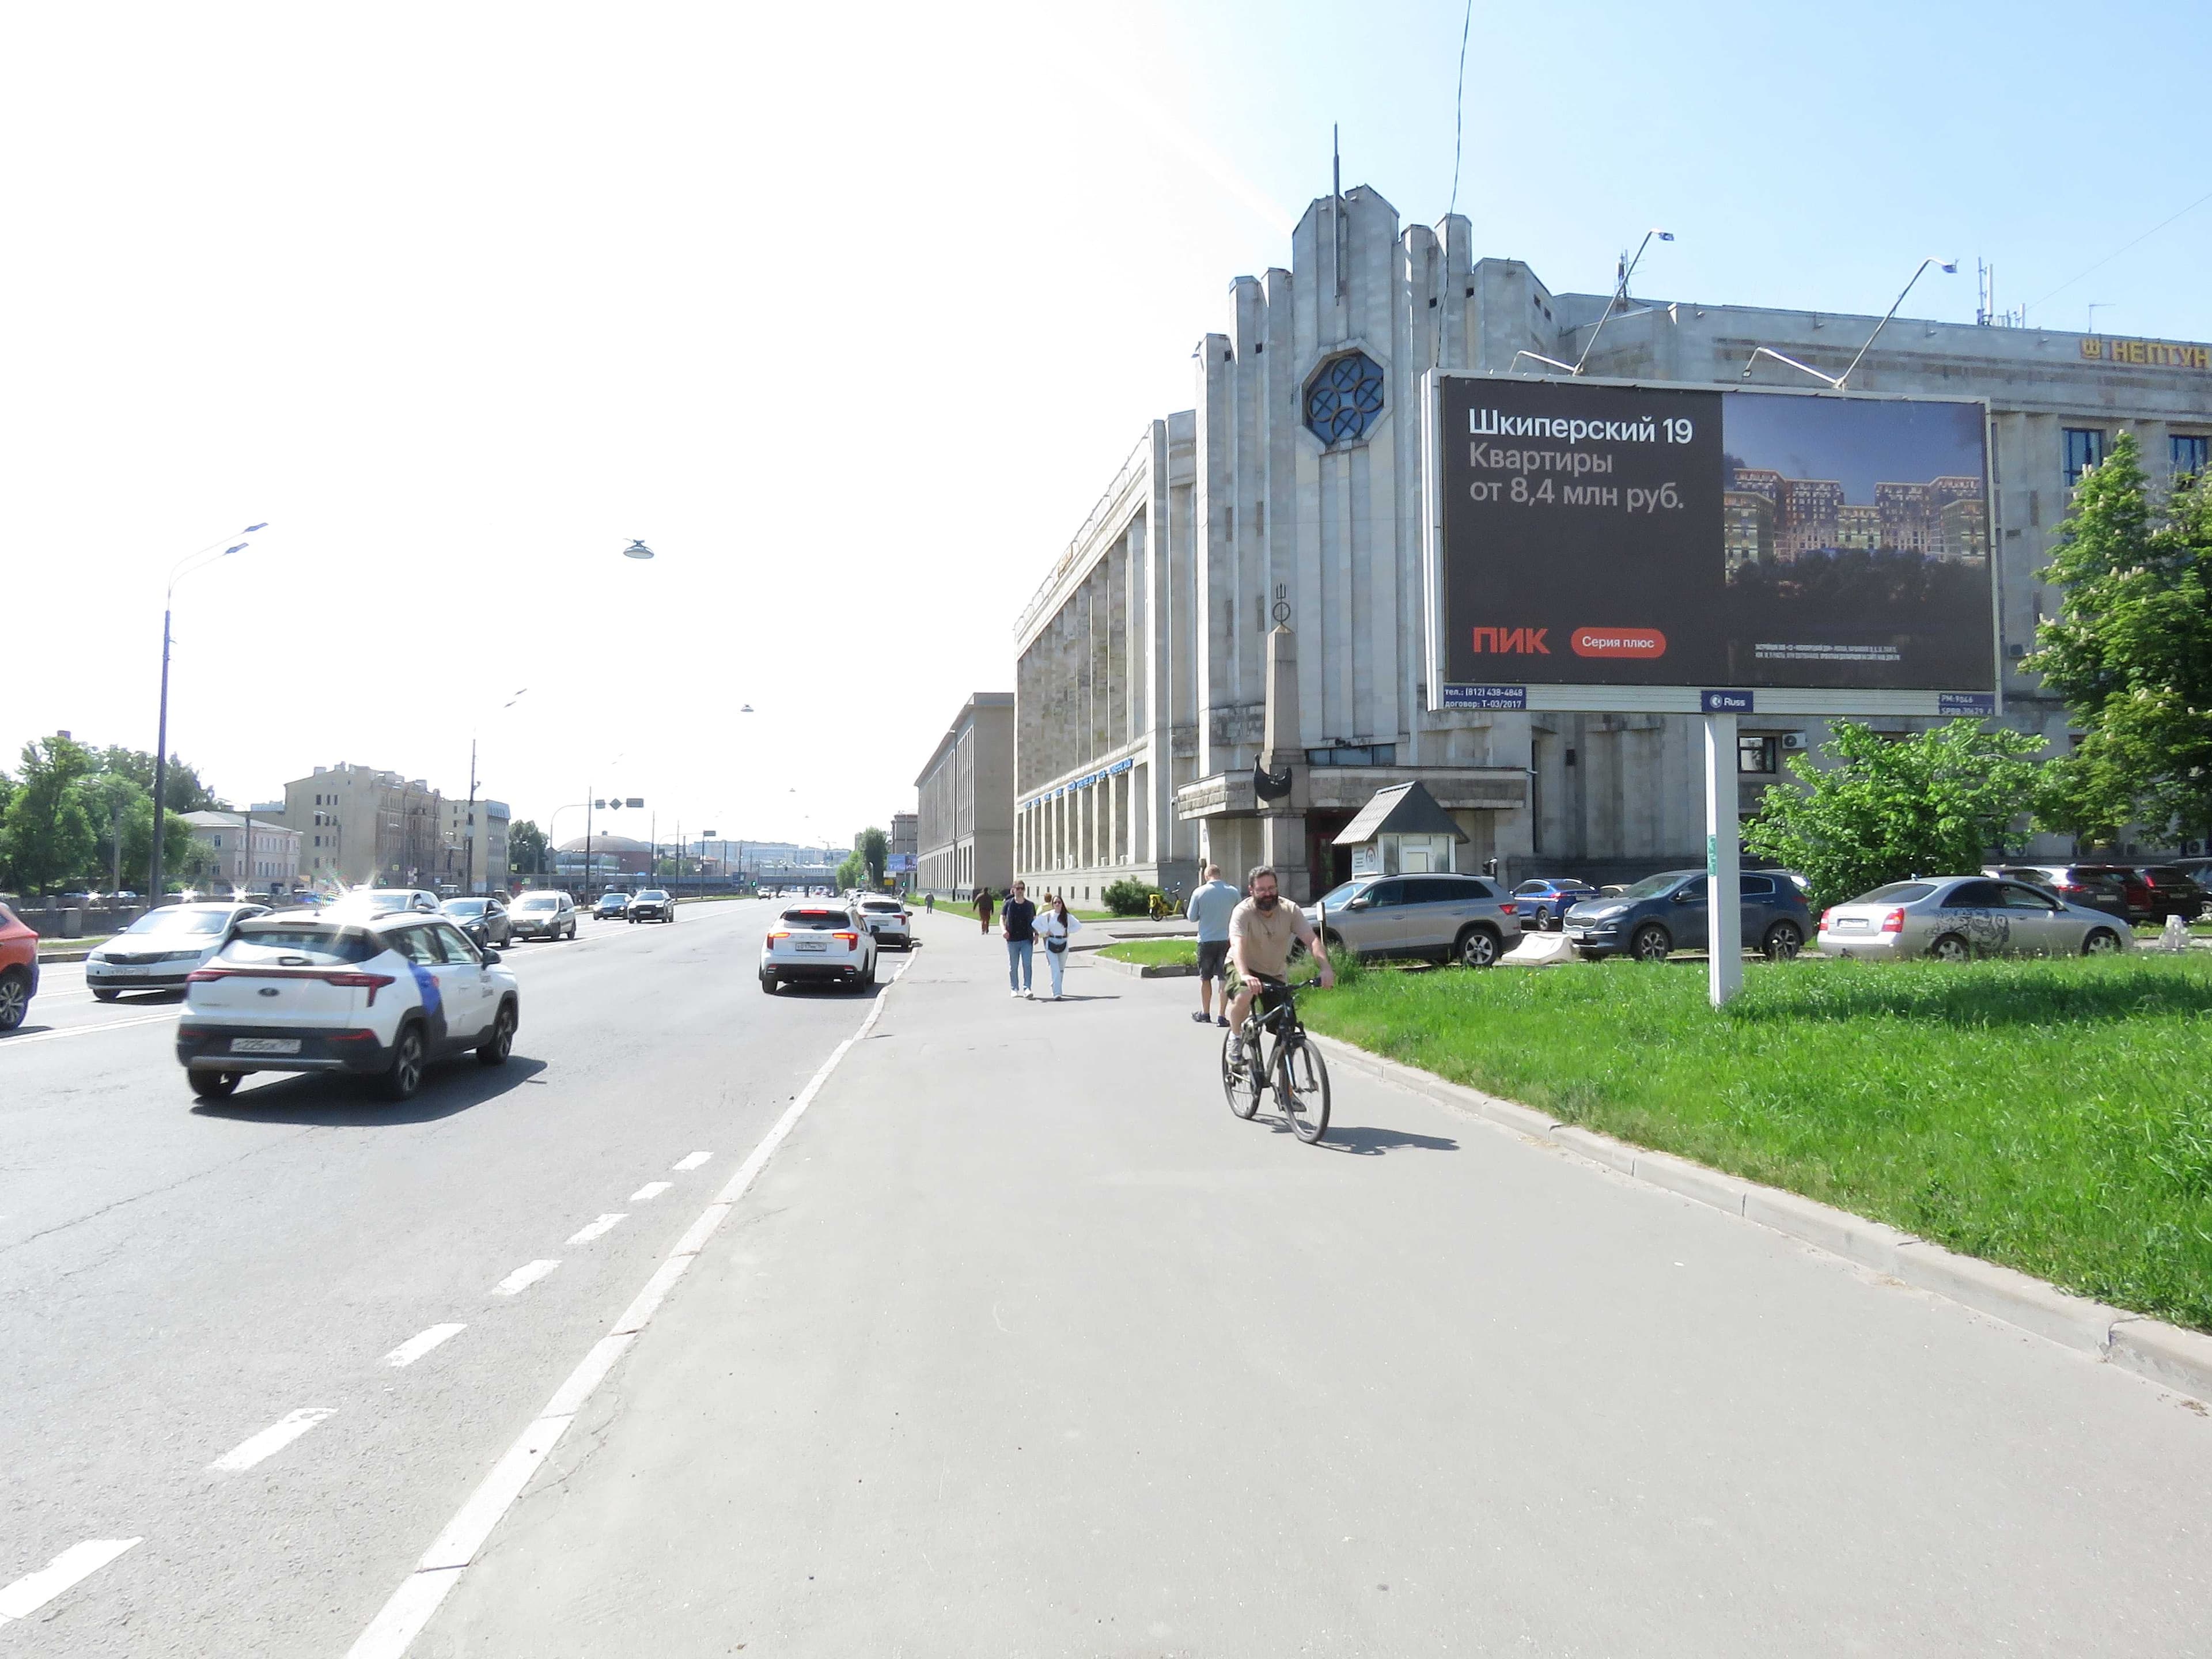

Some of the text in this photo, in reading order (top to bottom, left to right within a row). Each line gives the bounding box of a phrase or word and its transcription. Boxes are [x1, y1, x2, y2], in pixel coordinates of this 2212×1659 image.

[2109, 339, 2211, 369] НЕПТУН
[1469, 408, 1694, 444] Шкиперский 19
[1469, 441, 1613, 478] Квартиры
[1469, 476, 1684, 513] от 8,4 млн руб.
[1473, 626, 1551, 654] ПИК
[1582, 635, 1655, 649] Серия плюс
[1445, 700, 1480, 709] договор:
[1465, 687, 1485, 696] (812)
[1724, 697, 1746, 707] Russ
